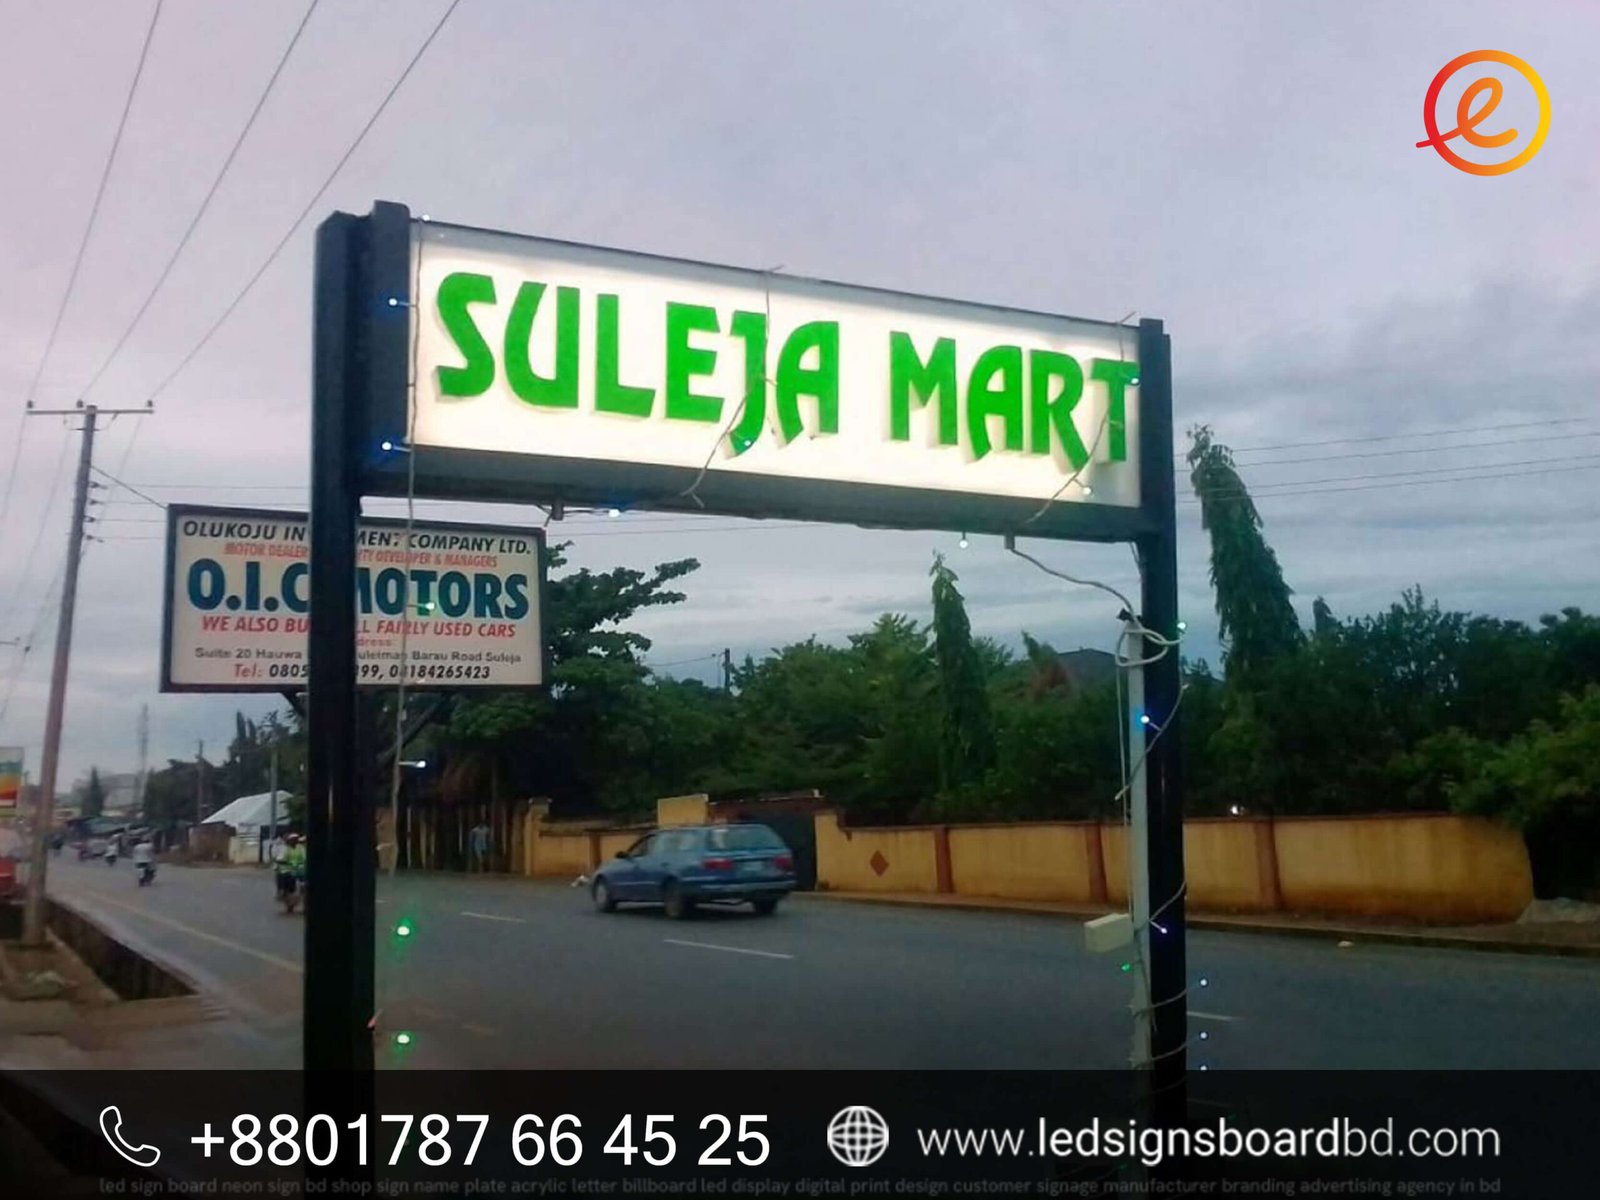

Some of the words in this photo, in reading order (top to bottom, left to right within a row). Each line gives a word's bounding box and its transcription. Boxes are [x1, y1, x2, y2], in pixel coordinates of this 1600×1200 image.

[435, 271, 840, 459] SULEJA
[889, 331, 1140, 472] MART
[183, 520, 277, 540] OLUKOJU
[408, 533, 496, 553] COMPANY
[499, 539, 532, 555] LTD.
[224, 543, 266, 557] MOTOR
[444, 554, 499, 568] MANAGERS
[202, 615, 231, 632] WE
[234, 617, 279, 633] ALSO
[284, 618, 309, 634] BU
[377, 620, 430, 635] FAIRLY
[433, 622, 473, 637] USED
[477, 623, 516, 638] CARS
[195, 647, 232, 660] Suite
[236, 648, 252, 660] 20
[256, 648, 303, 660] Hauwa
[452, 652, 483, 663] Road
[486, 652, 522, 665] Suleja
[234, 663, 263, 678] Tel:
